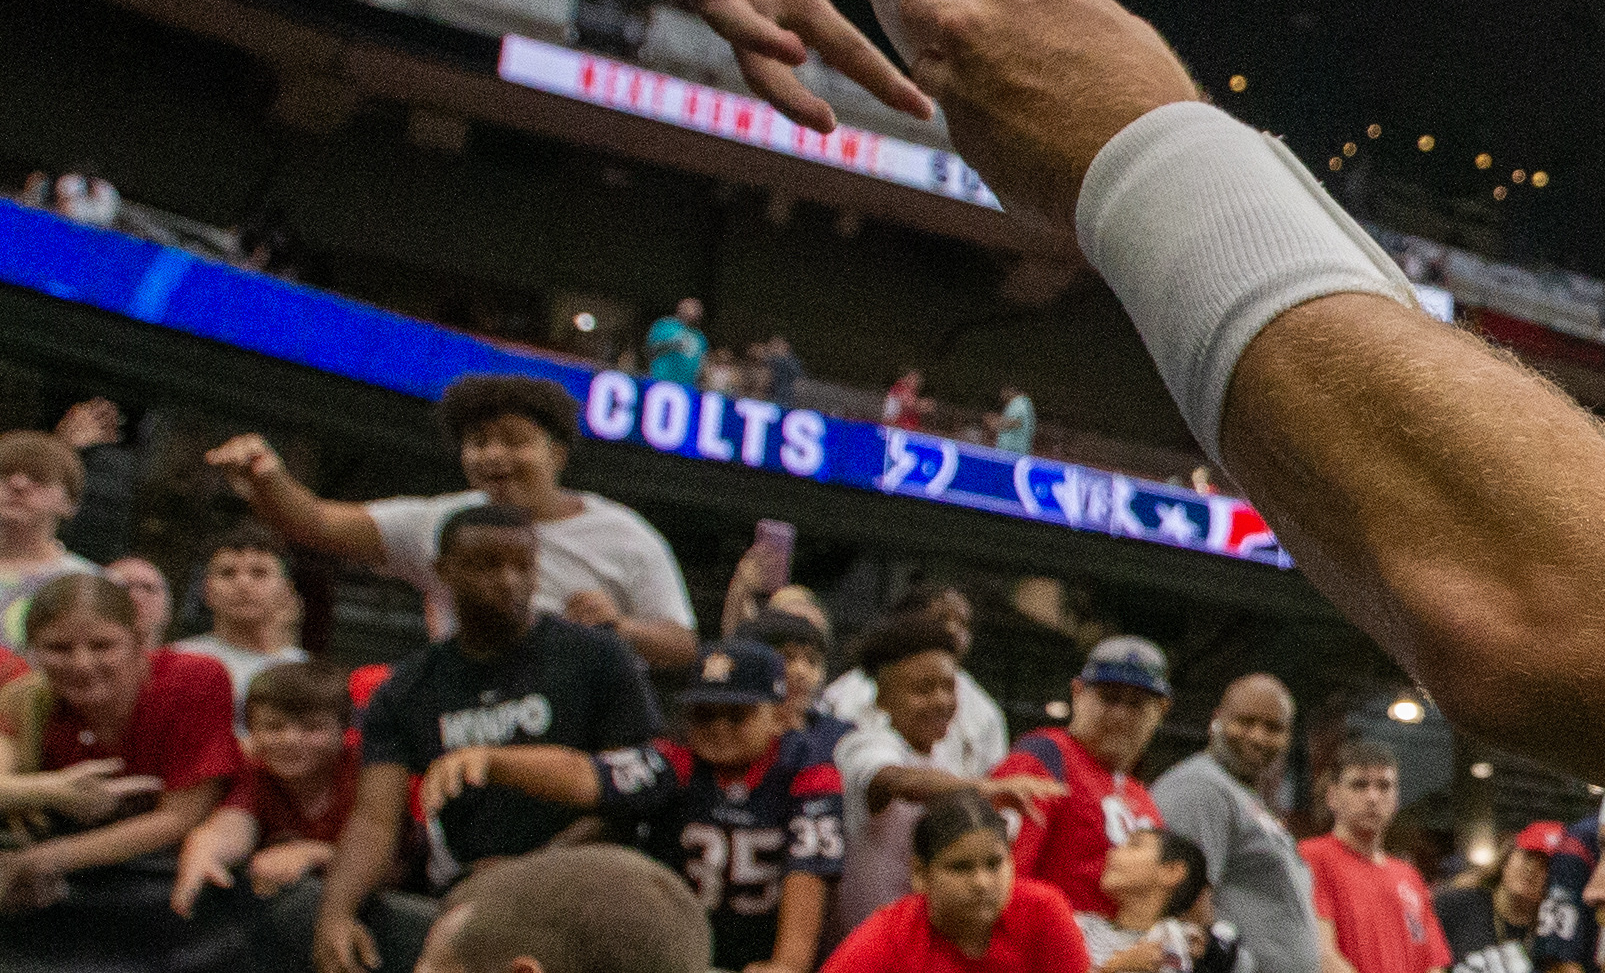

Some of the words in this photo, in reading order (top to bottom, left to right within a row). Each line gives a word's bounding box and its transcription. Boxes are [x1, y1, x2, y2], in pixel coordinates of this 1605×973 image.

[586, 370, 826, 476] COLTS
[680, 822, 787, 917] 35
[789, 814, 845, 859] 35
